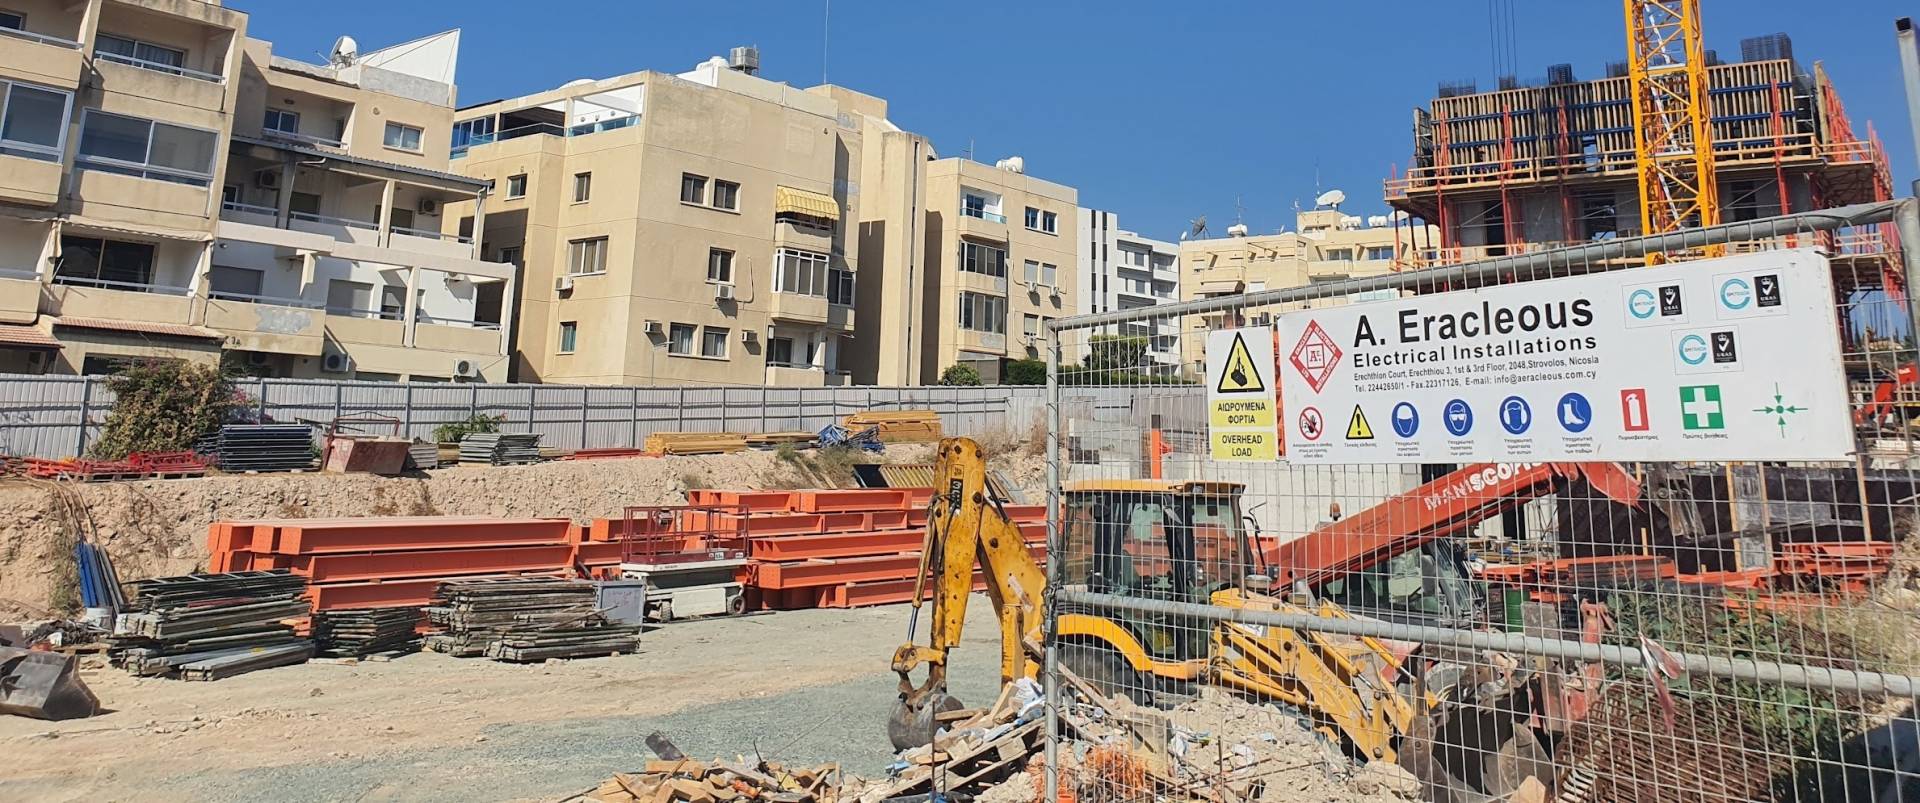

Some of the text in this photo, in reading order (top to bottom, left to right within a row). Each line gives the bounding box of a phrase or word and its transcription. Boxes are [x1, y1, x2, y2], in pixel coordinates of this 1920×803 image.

[1354, 298, 1594, 347] A. Eracleous
[1354, 336, 1596, 368] Electrical Installations
[1354, 372, 1386, 381] Erechthion
[1388, 370, 1408, 379] Court,
[1409, 368, 1444, 377] Erechthiou
[1446, 366, 1452, 375] 3,
[1454, 365, 1464, 374] 1st
[1466, 364, 1472, 373] &
[1473, 363, 1484, 372] 3rd
[1487, 362, 1507, 371] Floor,
[1569, 355, 1600, 365] Nicosia
[1355, 384, 1366, 392] Tel.
[1466, 376, 1492, 386] E-mail:
[1494, 370, 1596, 384] info@aeracleous.com.cy
[1218, 402, 1266, 412] ΑΙΩΡΟΥΜΕΝΑ
[1228, 414, 1256, 424] ΦΟΡΤΙΑ
[1222, 434, 1262, 444] OVERHEAD
[1232, 448, 1252, 456] LOAD
